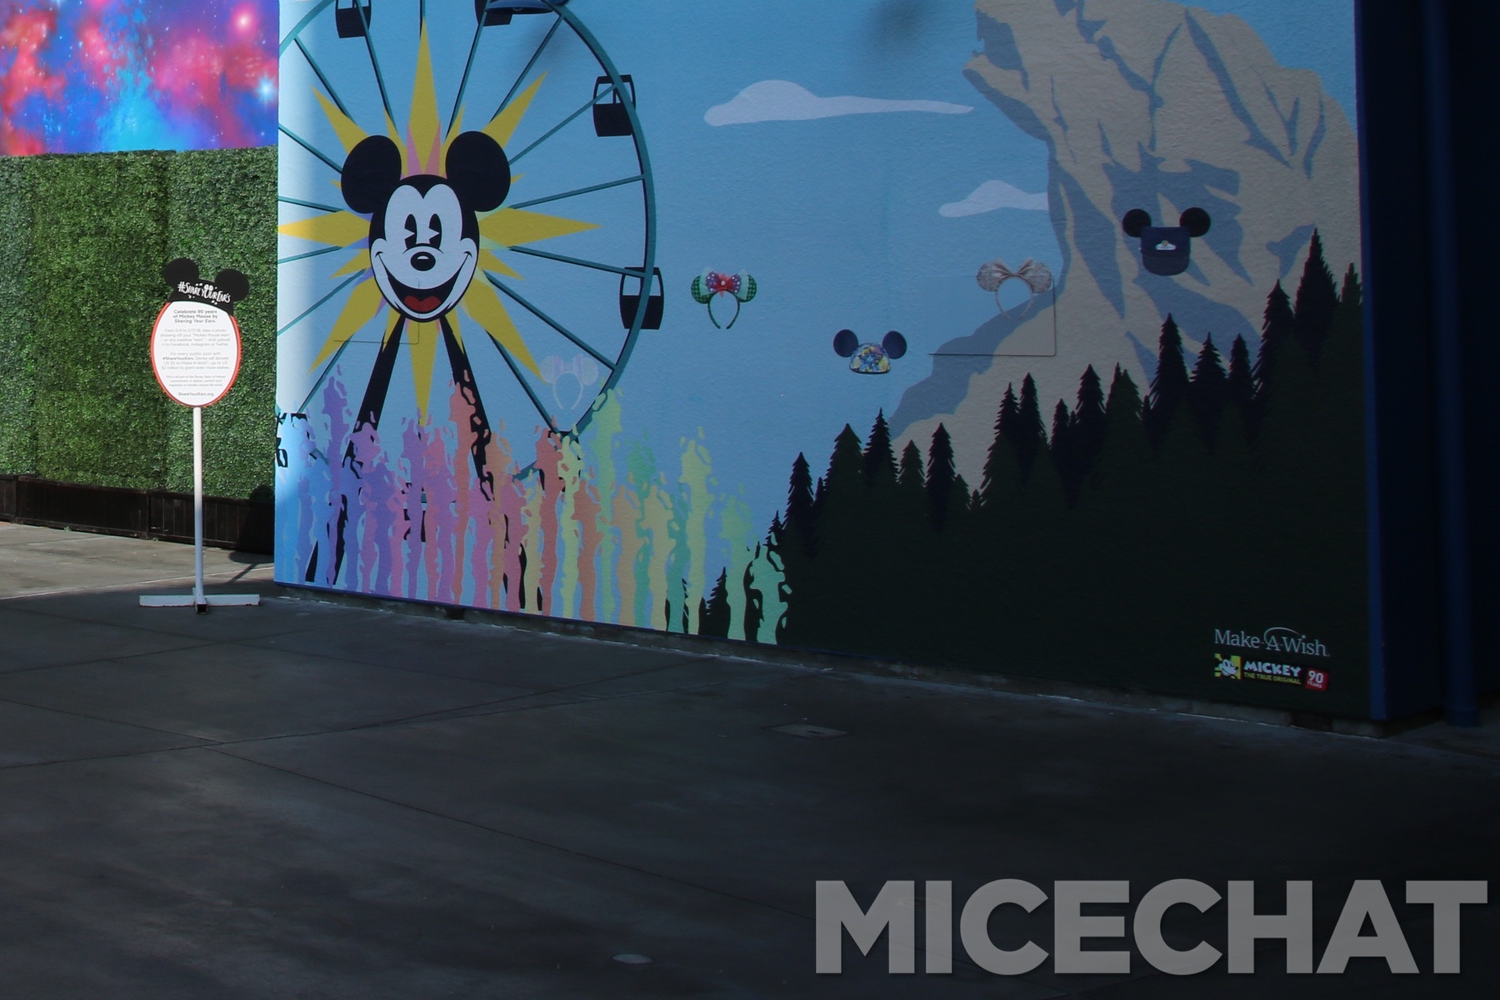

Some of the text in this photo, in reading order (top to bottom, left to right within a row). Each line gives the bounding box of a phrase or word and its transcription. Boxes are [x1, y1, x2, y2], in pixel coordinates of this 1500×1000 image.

[1244, 661, 1301, 677] MICKEY
[1257, 673, 1272, 681] TRUE
[1308, 670, 1324, 684] 90
